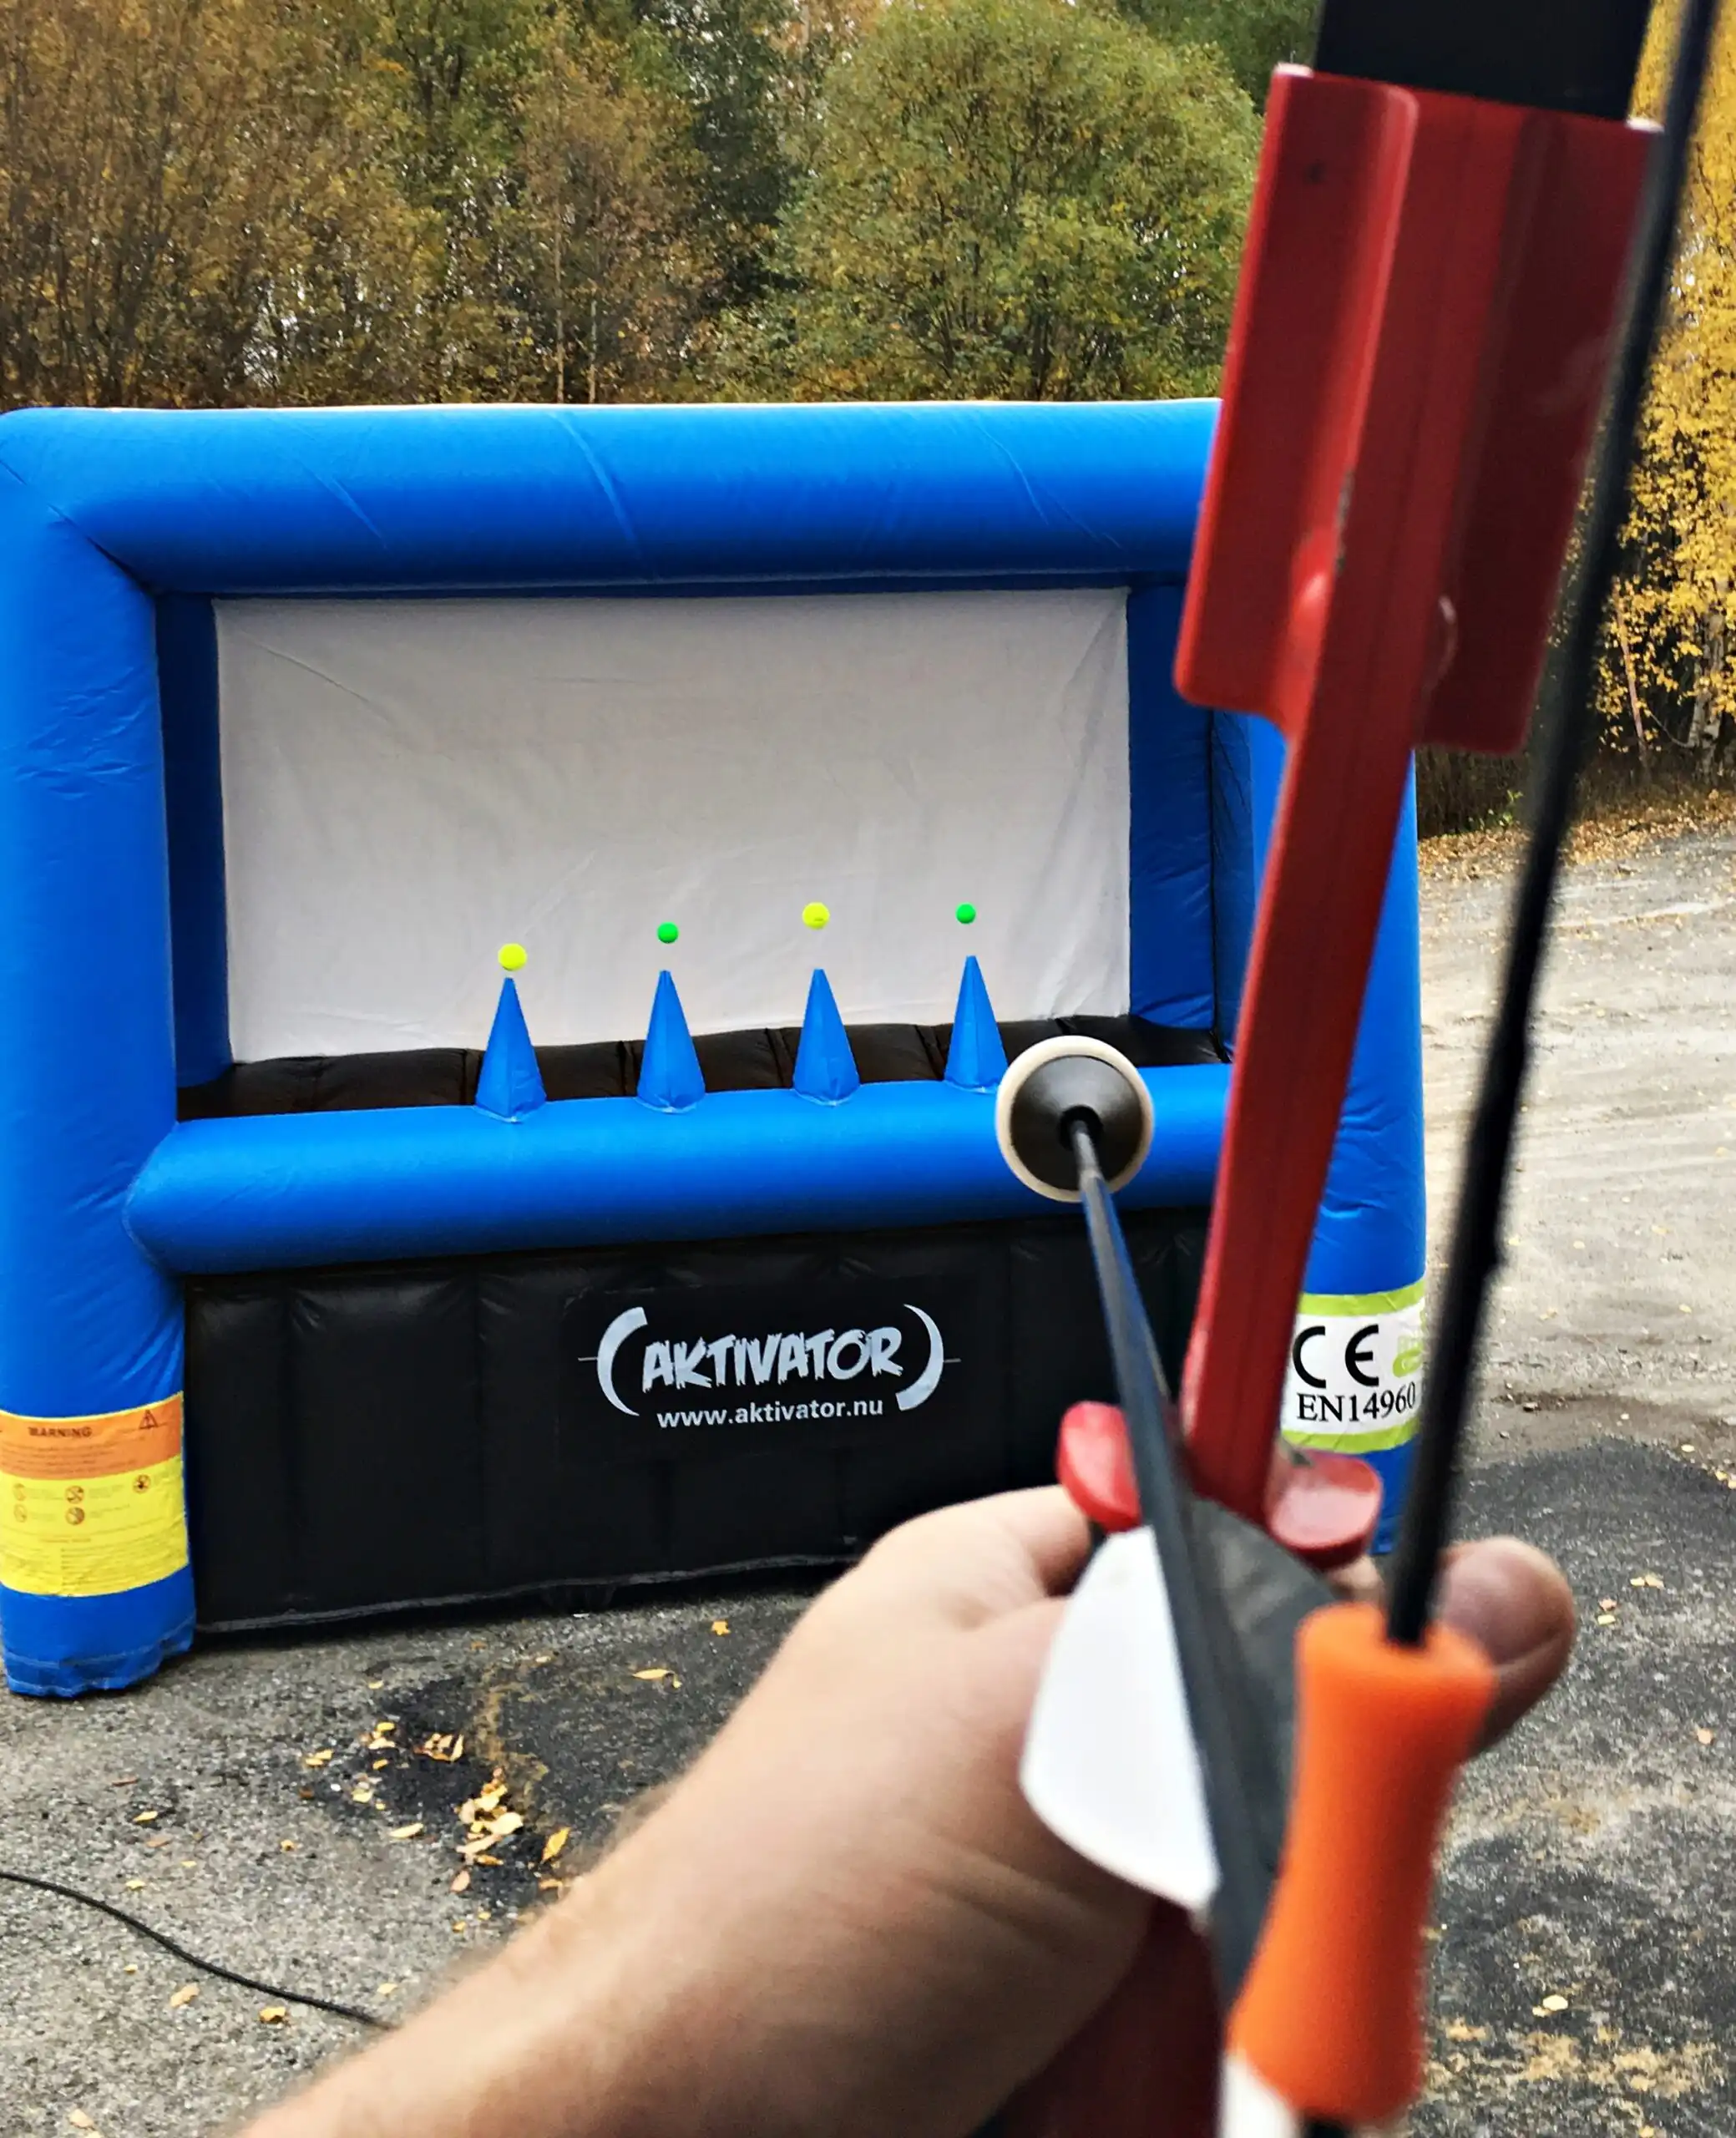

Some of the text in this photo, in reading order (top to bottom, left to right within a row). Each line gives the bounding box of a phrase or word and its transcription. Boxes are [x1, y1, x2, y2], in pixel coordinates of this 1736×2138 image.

[642, 1327, 903, 1393] AKTIVATOR
[1293, 1325, 1379, 1388] CE
[656, 1399, 883, 1428] www.aktivator.nu
[1296, 1381, 1415, 1422] EN14960
